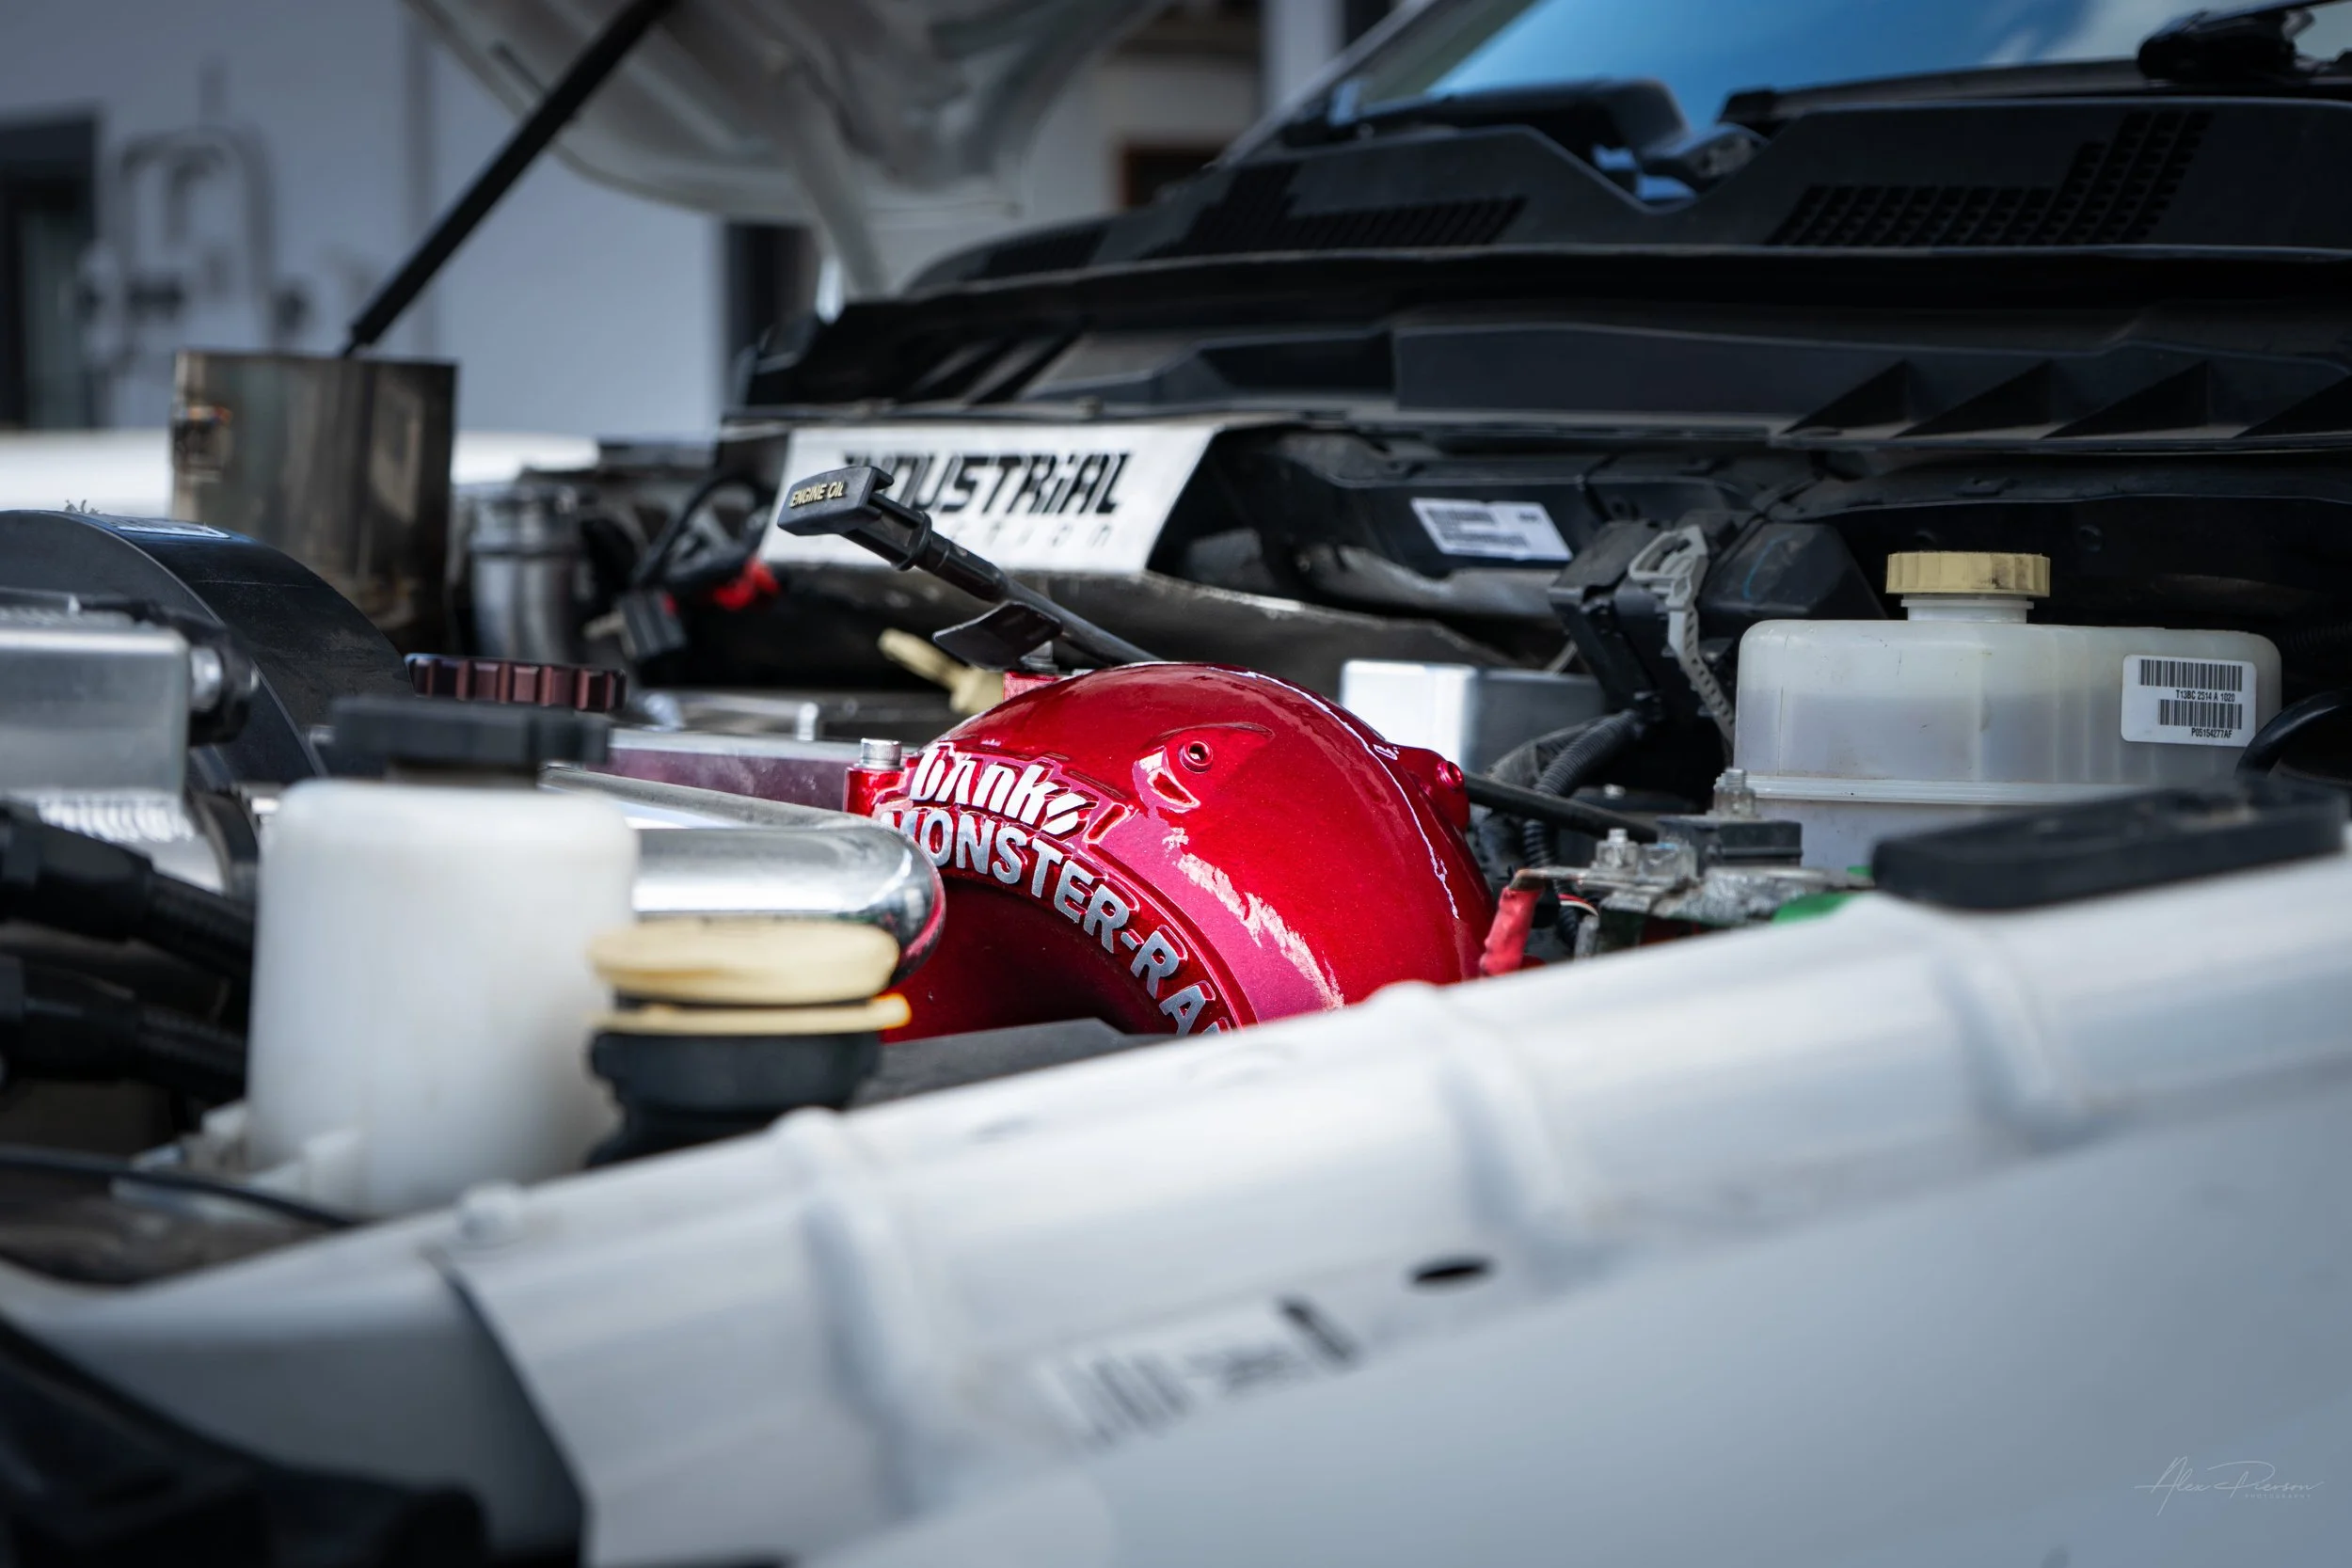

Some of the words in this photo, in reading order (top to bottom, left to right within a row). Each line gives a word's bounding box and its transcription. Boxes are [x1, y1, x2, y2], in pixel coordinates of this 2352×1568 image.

[790, 483, 827, 508] ENGINE
[828, 481, 845, 498] OIL
[881, 807, 1224, 1036] ONSTER-RA
